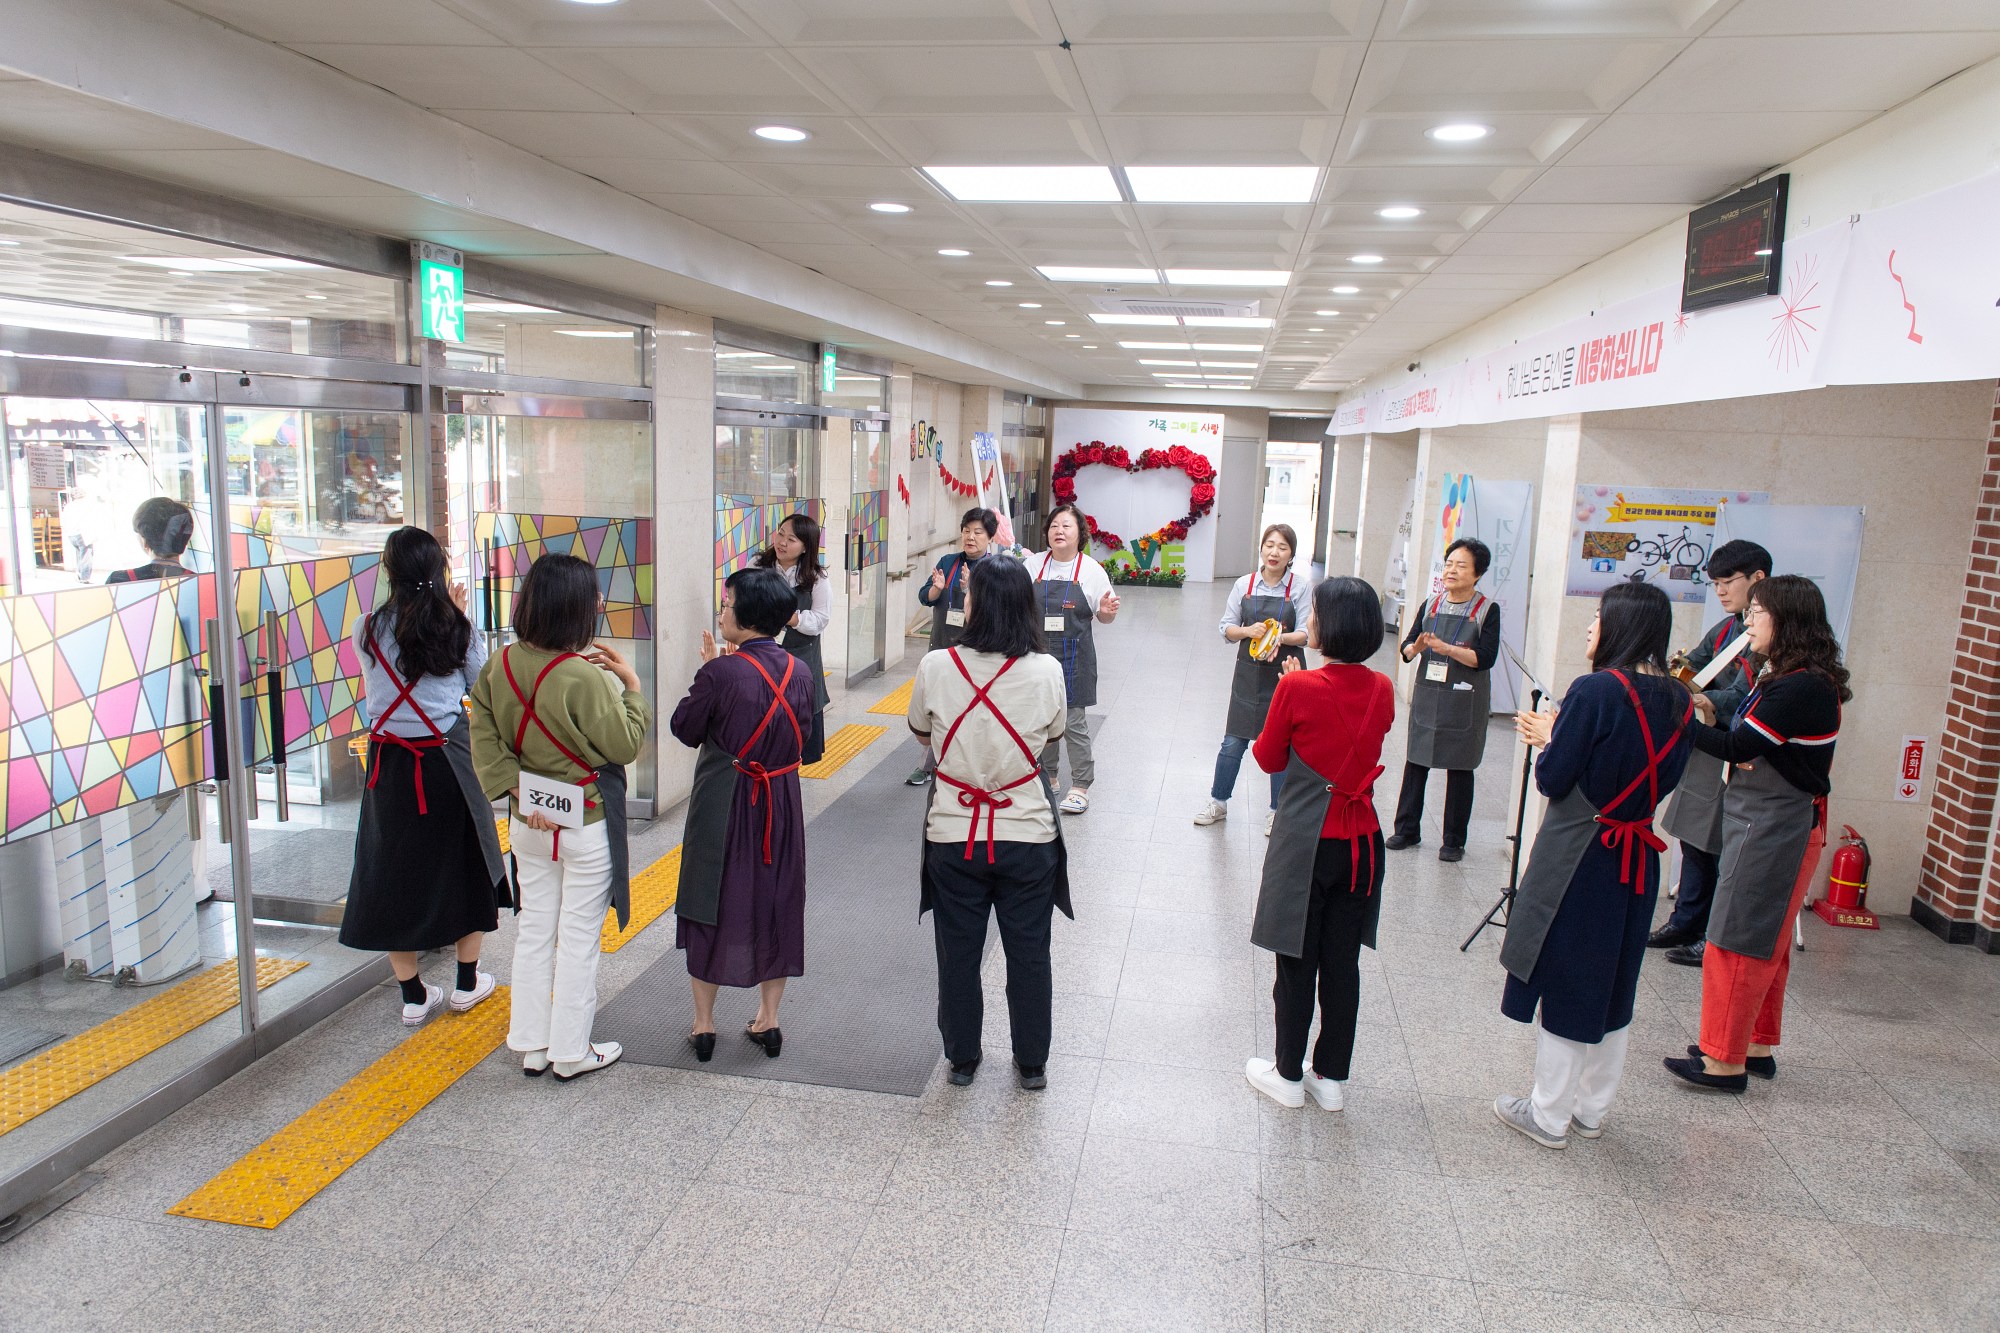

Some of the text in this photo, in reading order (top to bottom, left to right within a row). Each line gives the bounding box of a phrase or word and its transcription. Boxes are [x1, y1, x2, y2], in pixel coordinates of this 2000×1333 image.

[1507, 321, 1664, 399] 하나님은 당신을 사랑하십니다
[1149, 418, 1167, 432] 가족
[1201, 423, 1219, 435] 사랑
[1908, 748, 1921, 778] 소화기
[529, 788, 572, 813] 여2조
[1846, 915, 1873, 924] 소화기
